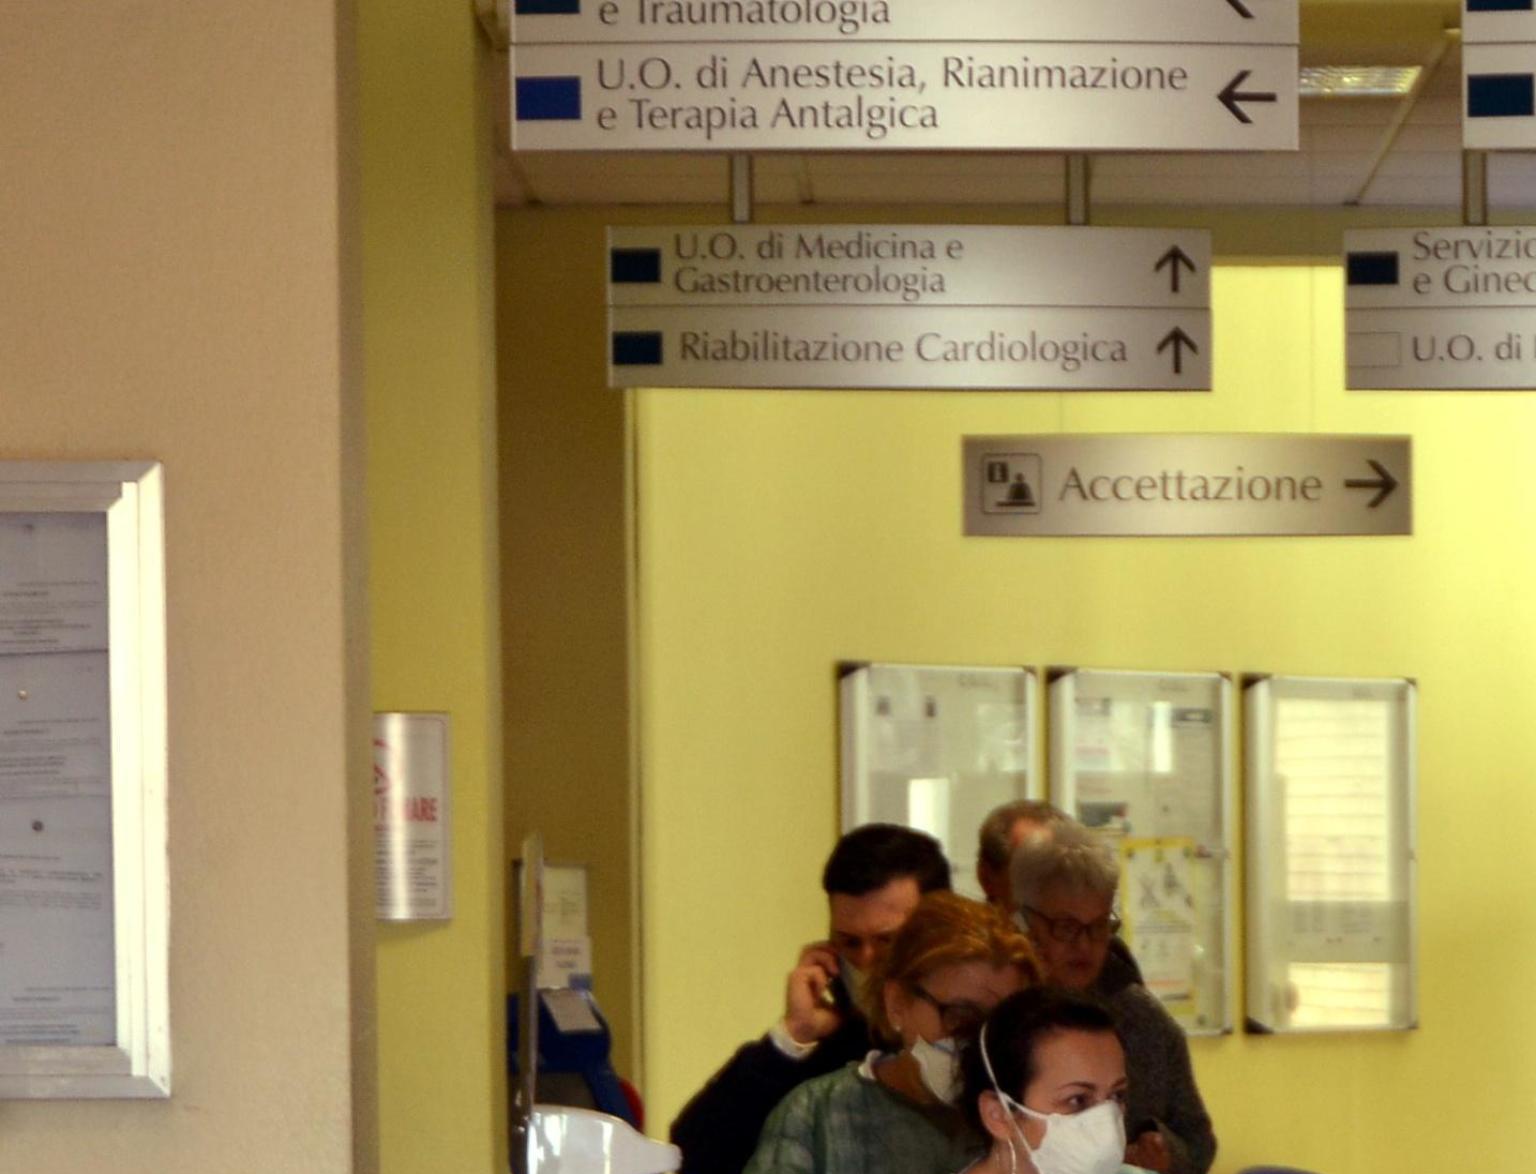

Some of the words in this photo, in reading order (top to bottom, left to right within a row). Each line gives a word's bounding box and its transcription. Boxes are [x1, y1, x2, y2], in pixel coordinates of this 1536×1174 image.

[599, 0, 619, 25] e
[636, 0, 891, 35] Traumatologia
[597, 57, 680, 91] U.O.
[697, 56, 727, 90] di
[742, 57, 926, 95] Anestesia,
[943, 56, 1188, 91] Rianimazione
[596, 104, 618, 131] e
[629, 97, 758, 140] Terapia
[771, 95, 939, 141] Antalgica
[675, 235, 744, 261] U.O.
[757, 232, 785, 260] di
[795, 233, 935, 260] Medicina
[947, 241, 964, 260] e
[675, 264, 946, 302] Gastroenterologia
[1412, 272, 1432, 294] e
[680, 332, 905, 364] Riabilitazione
[917, 331, 1128, 373] Cardiologica
[1412, 336, 1484, 363] U.O.
[1495, 333, 1522, 362] di
[1058, 466, 1323, 503] Accettazione
